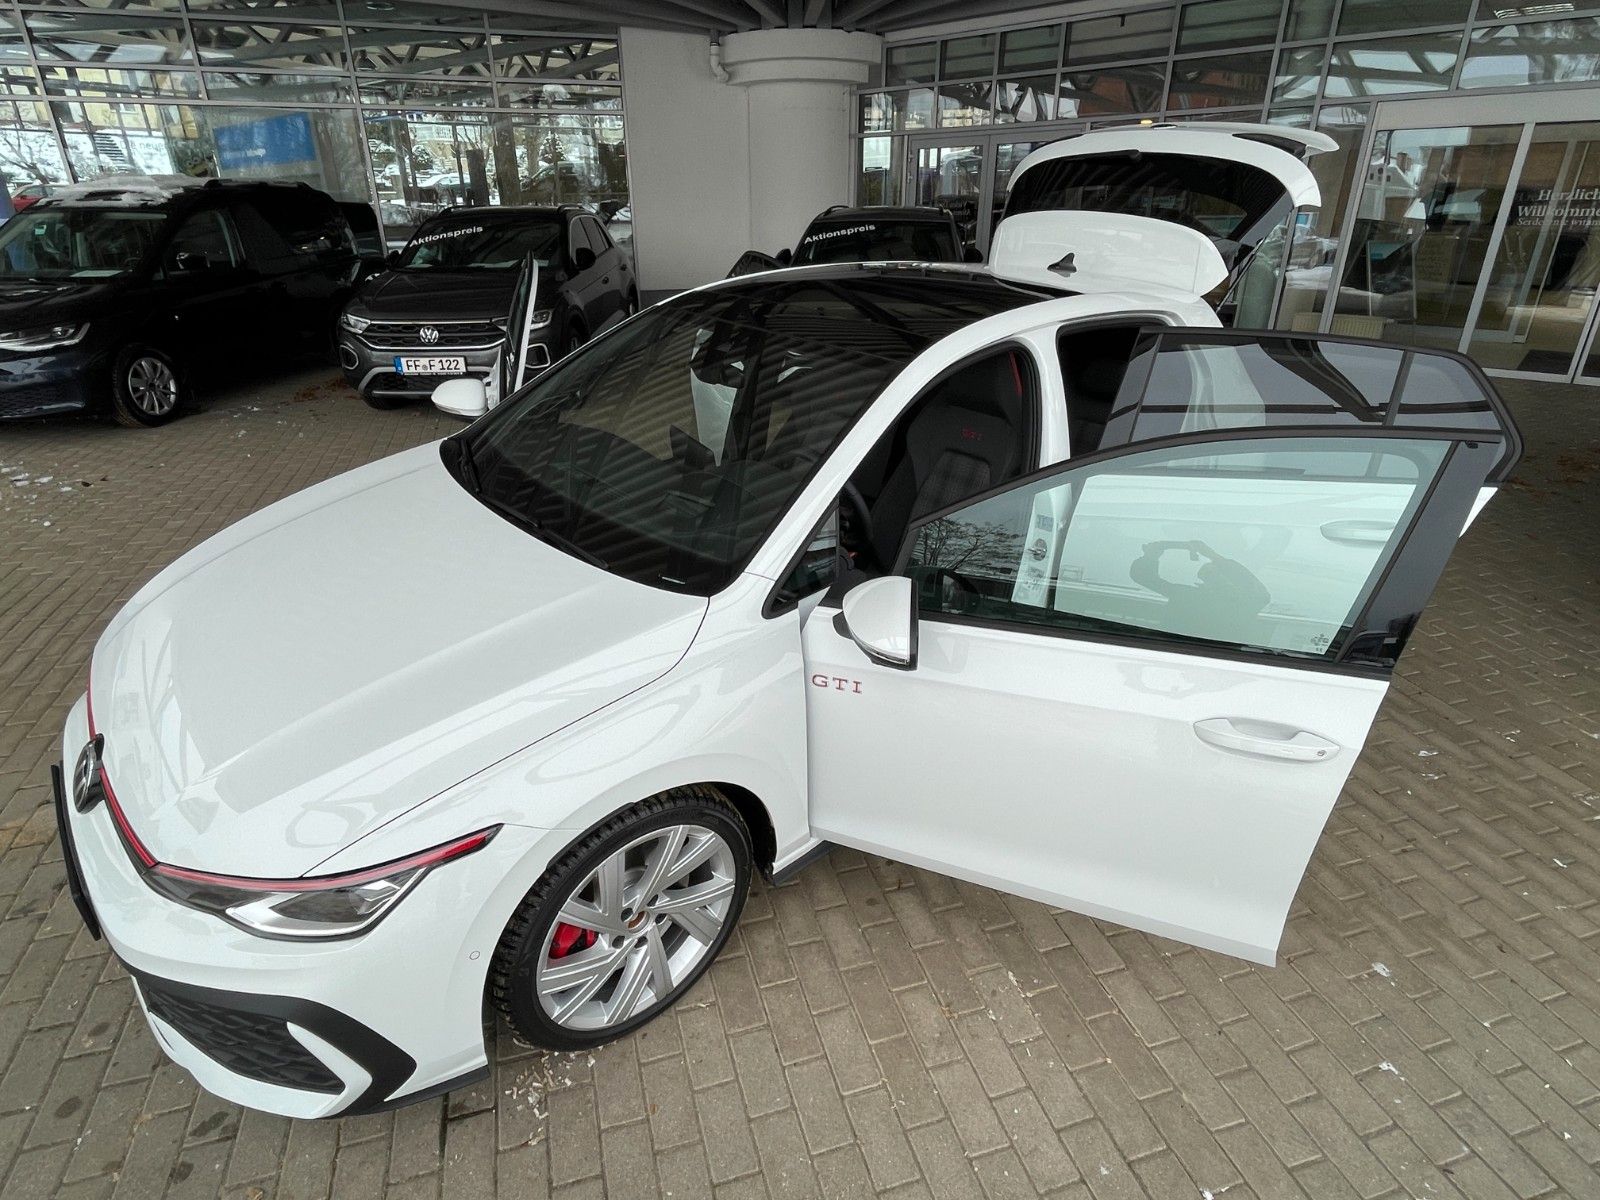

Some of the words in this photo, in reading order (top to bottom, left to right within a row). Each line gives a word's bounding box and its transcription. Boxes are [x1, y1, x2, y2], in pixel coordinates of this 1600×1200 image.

[409, 226, 483, 247] Aktionspreis
[804, 224, 876, 244] Aktionspreis
[406, 359, 420, 371] FF
[428, 359, 436, 371] F
[438, 359, 460, 371] 122
[812, 674, 862, 693] GTI
